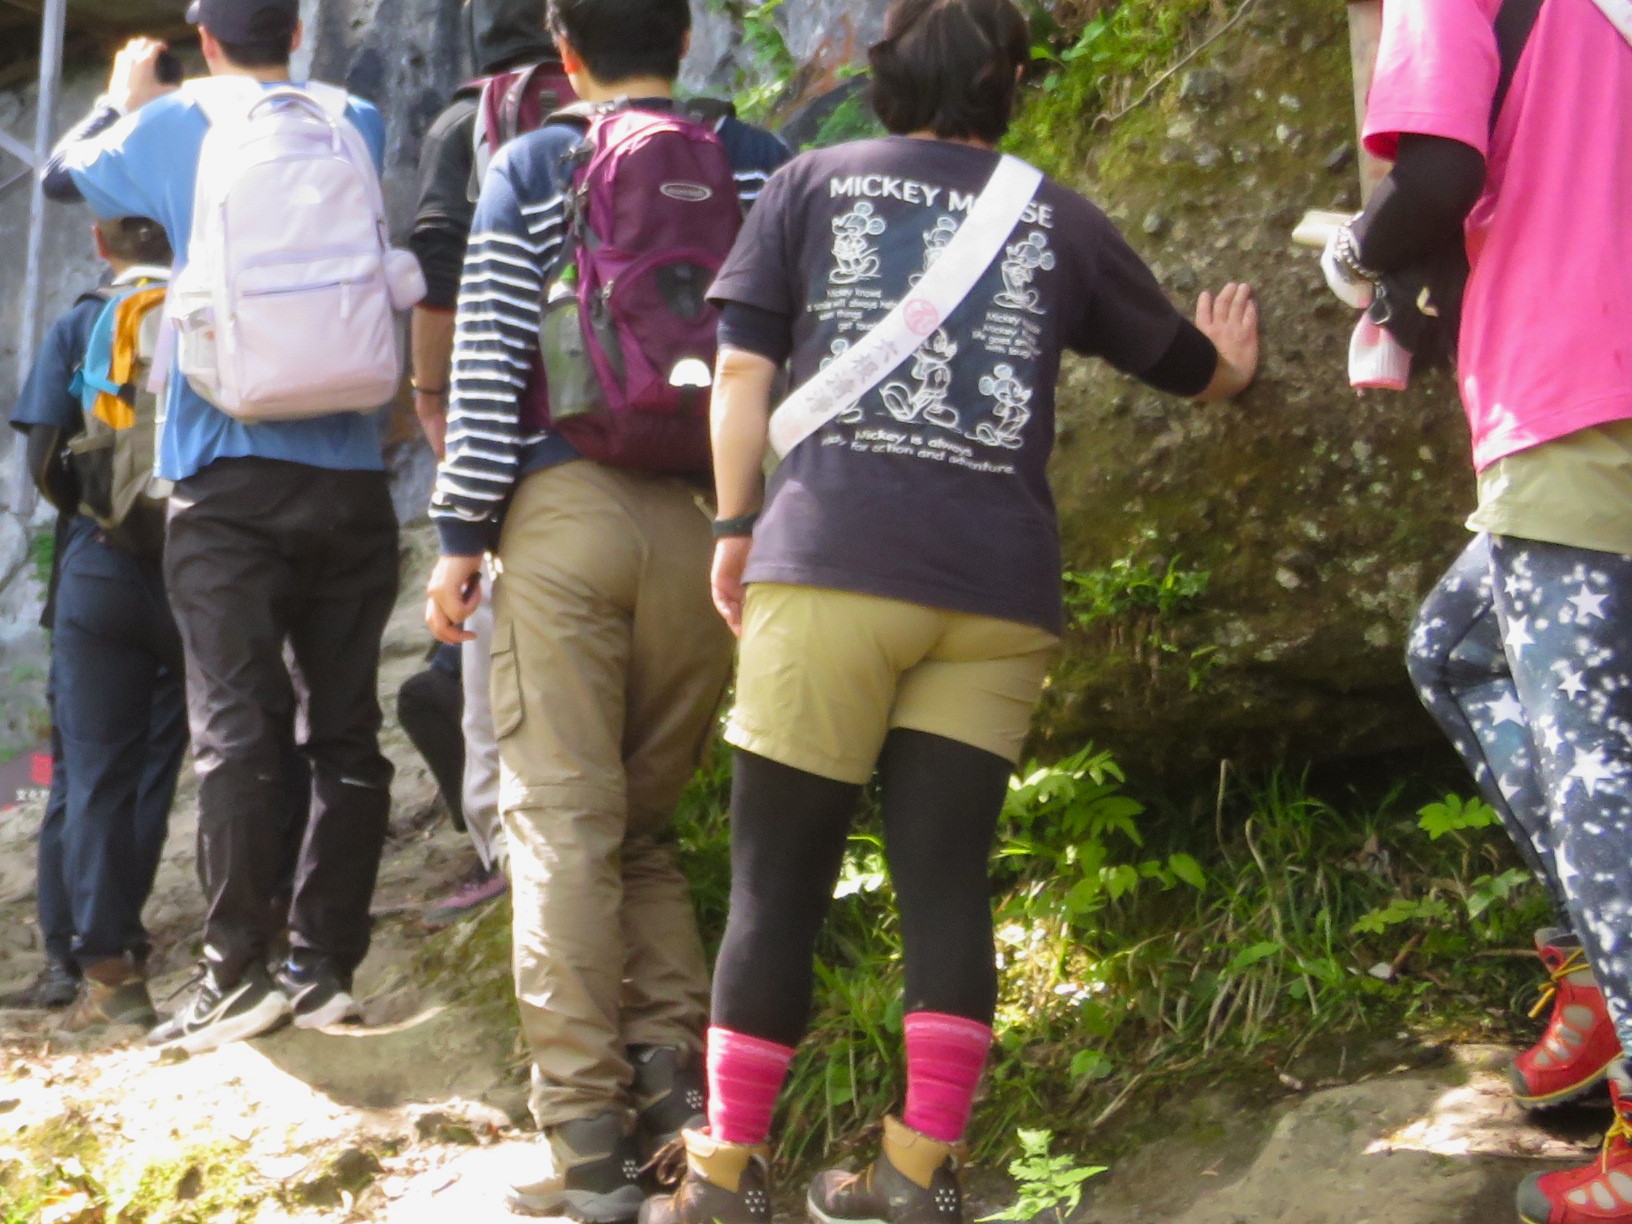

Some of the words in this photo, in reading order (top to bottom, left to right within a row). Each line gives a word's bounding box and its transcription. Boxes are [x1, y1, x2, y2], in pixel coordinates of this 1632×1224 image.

[830, 175, 942, 208] MICKEY
[948, 191, 1055, 229] MSE
[854, 429, 908, 446] Mickey
[916, 449, 946, 462] and
